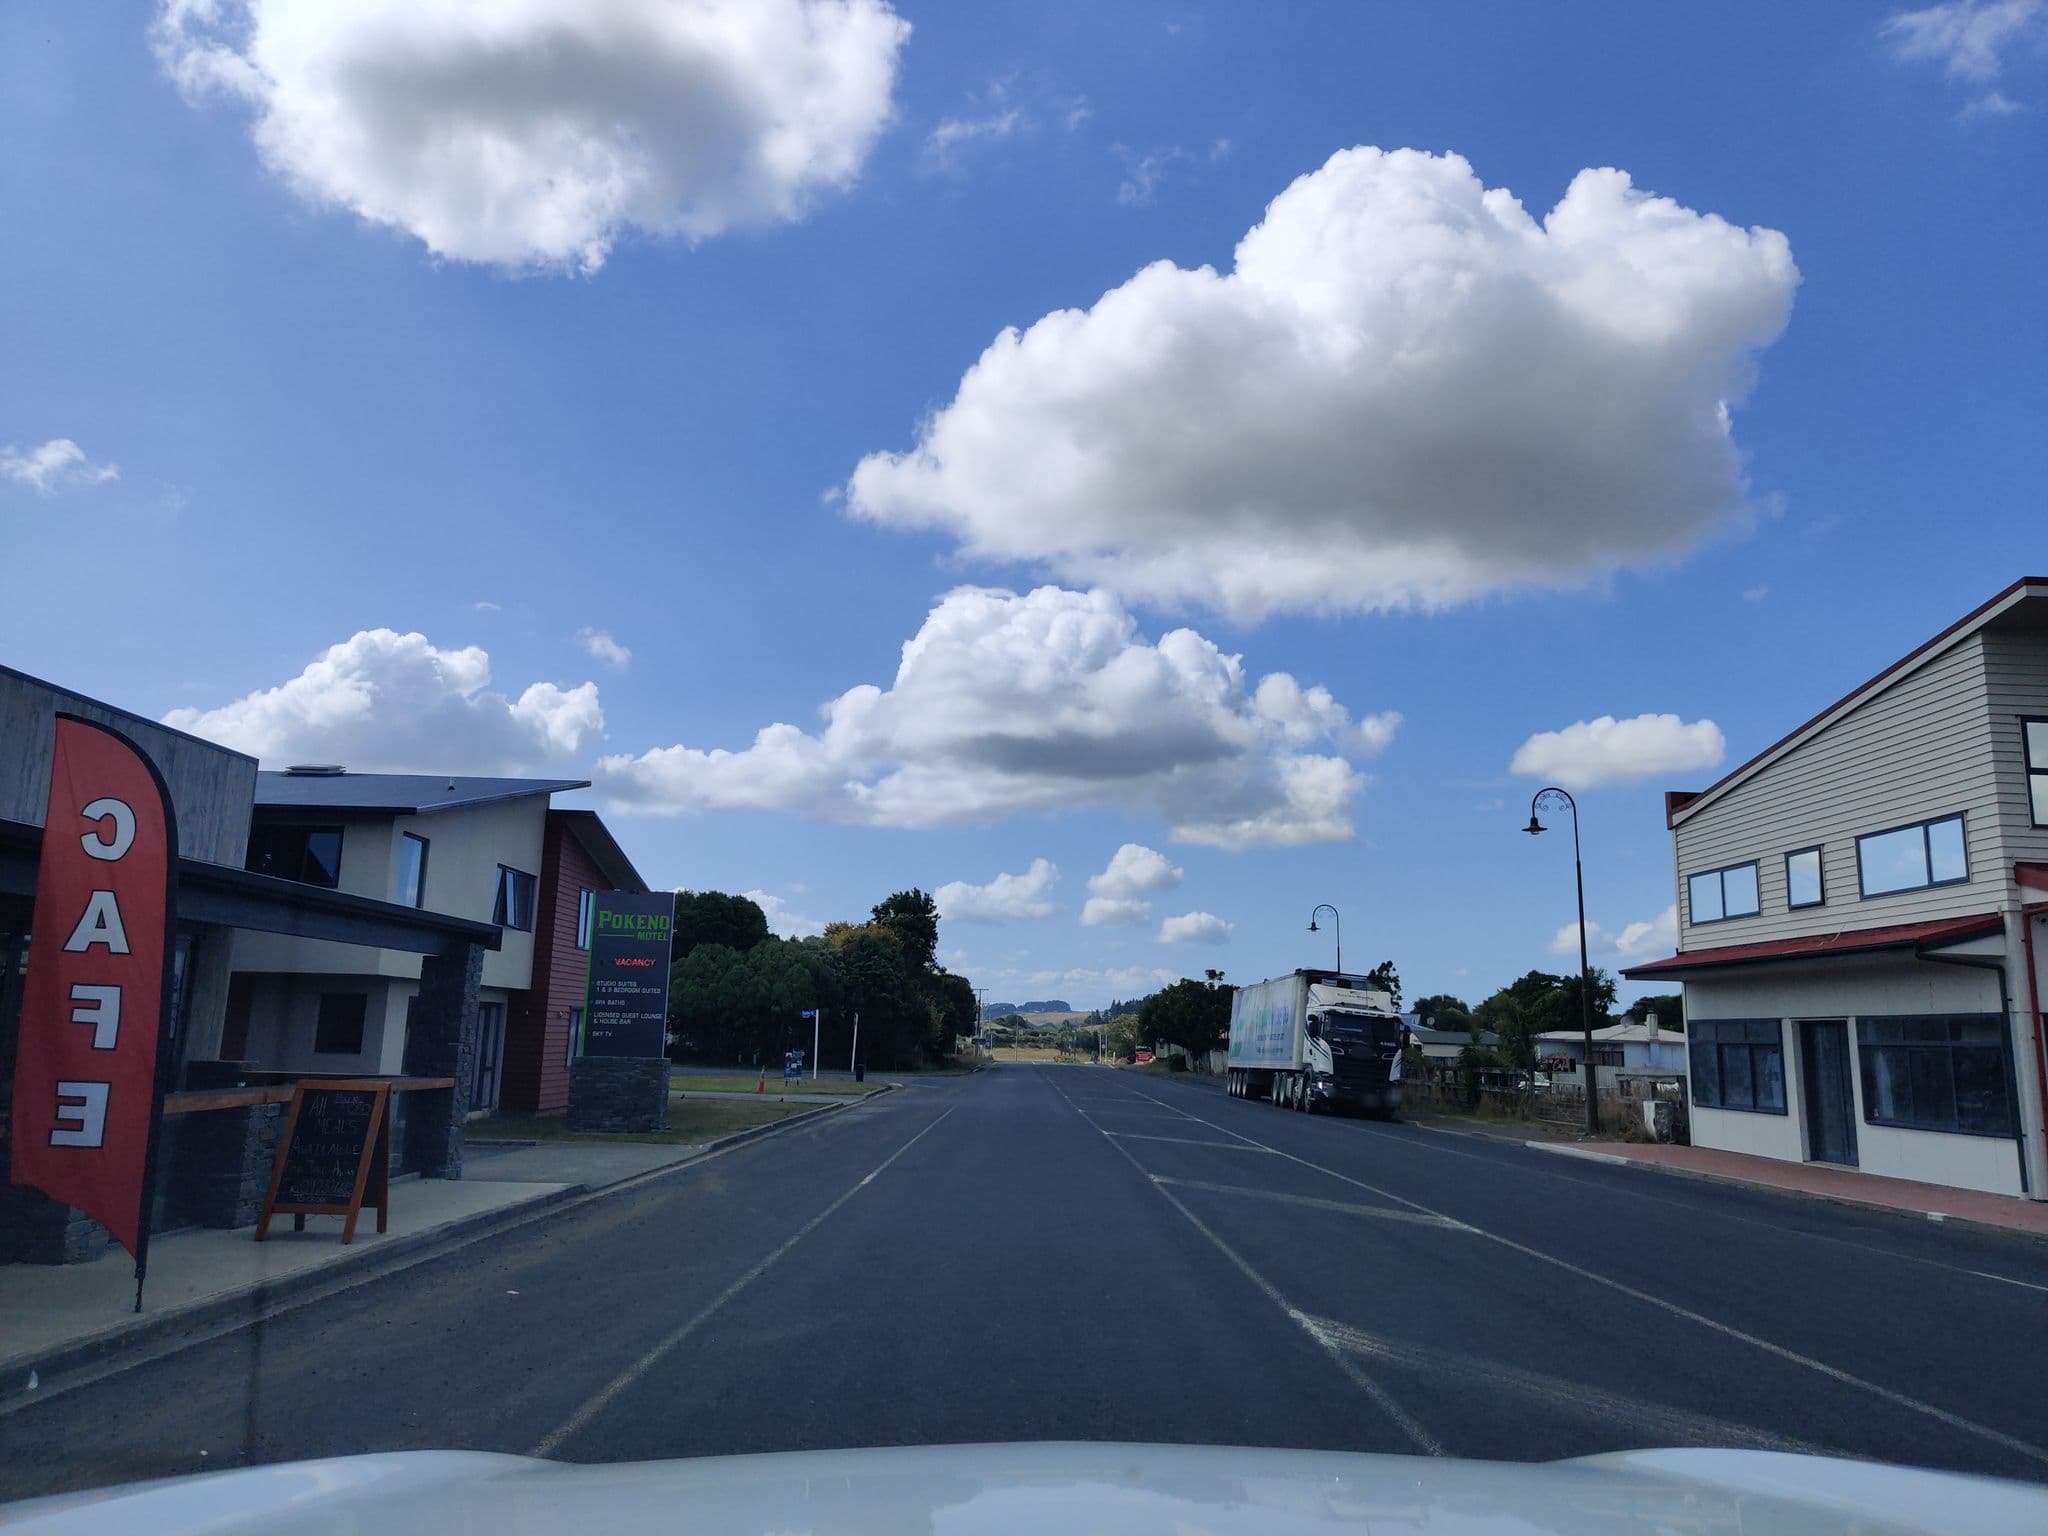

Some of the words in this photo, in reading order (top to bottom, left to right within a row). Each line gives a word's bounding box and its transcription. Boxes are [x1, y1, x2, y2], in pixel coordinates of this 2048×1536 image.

[598, 911, 670, 930] POKENO
[637, 931, 668, 941] MOTEL
[615, 958, 656, 966] VACANCY
